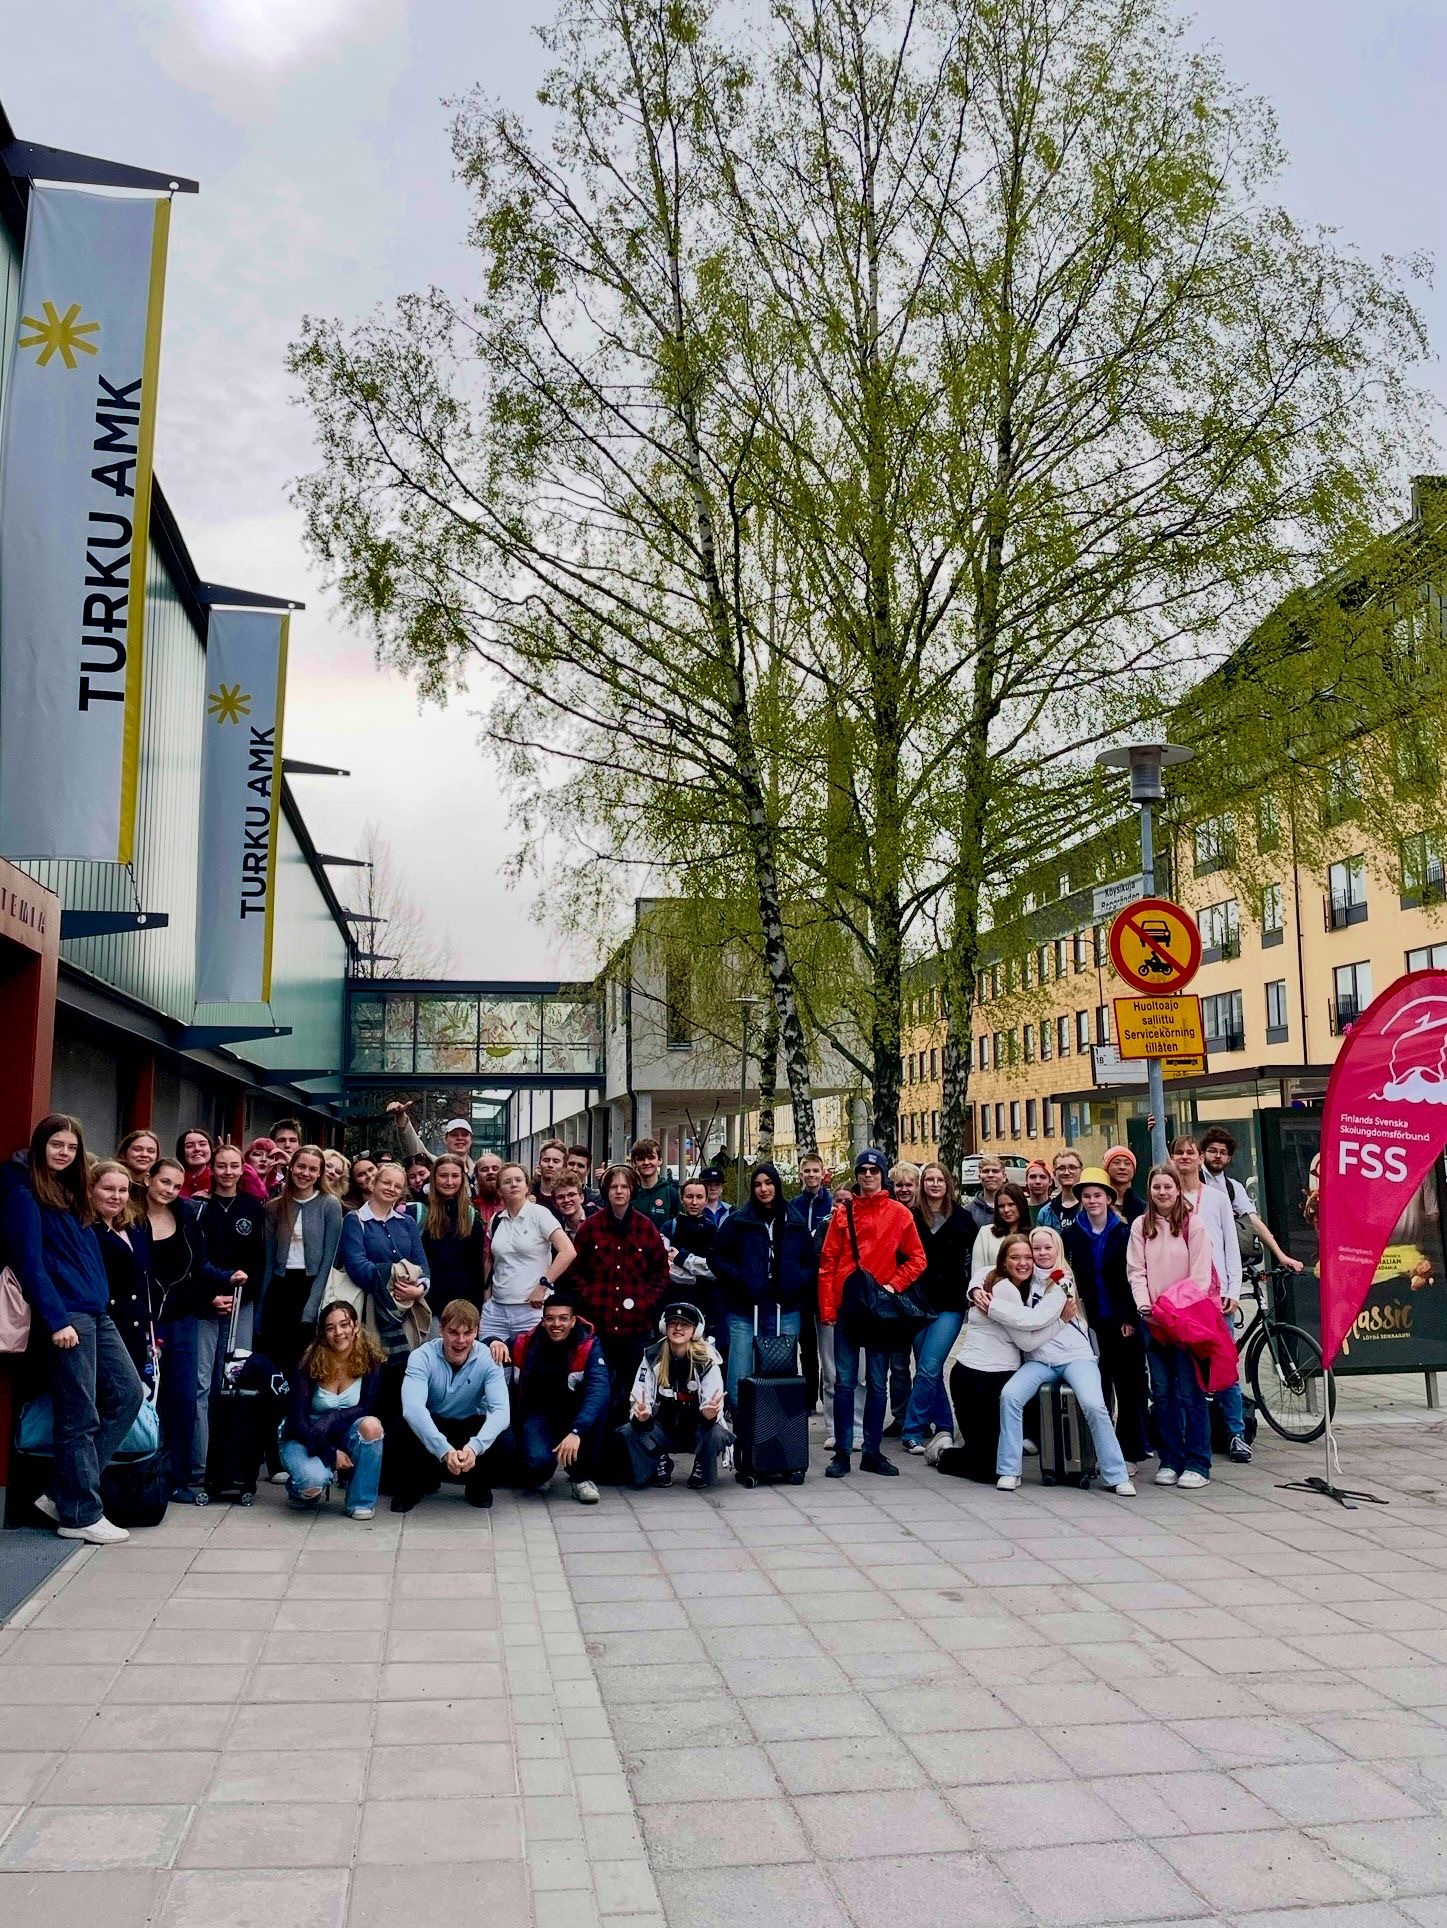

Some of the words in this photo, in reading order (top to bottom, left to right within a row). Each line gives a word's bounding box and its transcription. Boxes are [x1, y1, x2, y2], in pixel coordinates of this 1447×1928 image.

[90, 374, 143, 498] AMK
[78, 511, 134, 711] TURKU
[246, 725, 276, 798] AMK
[240, 805, 271, 920] TURKU
[1133, 1001, 1179, 1015] Huoltoajo
[1142, 1016, 1175, 1026] sallittu
[1124, 1027, 1196, 1041] Servicekörning
[1145, 1041, 1179, 1054] tillåten
[1340, 1113, 1374, 1125] Finlands
[1374, 1116, 1409, 1128] Svenska
[1339, 1125, 1431, 1142] Skolungdomsförbund
[1338, 1140, 1409, 1183] FSS
